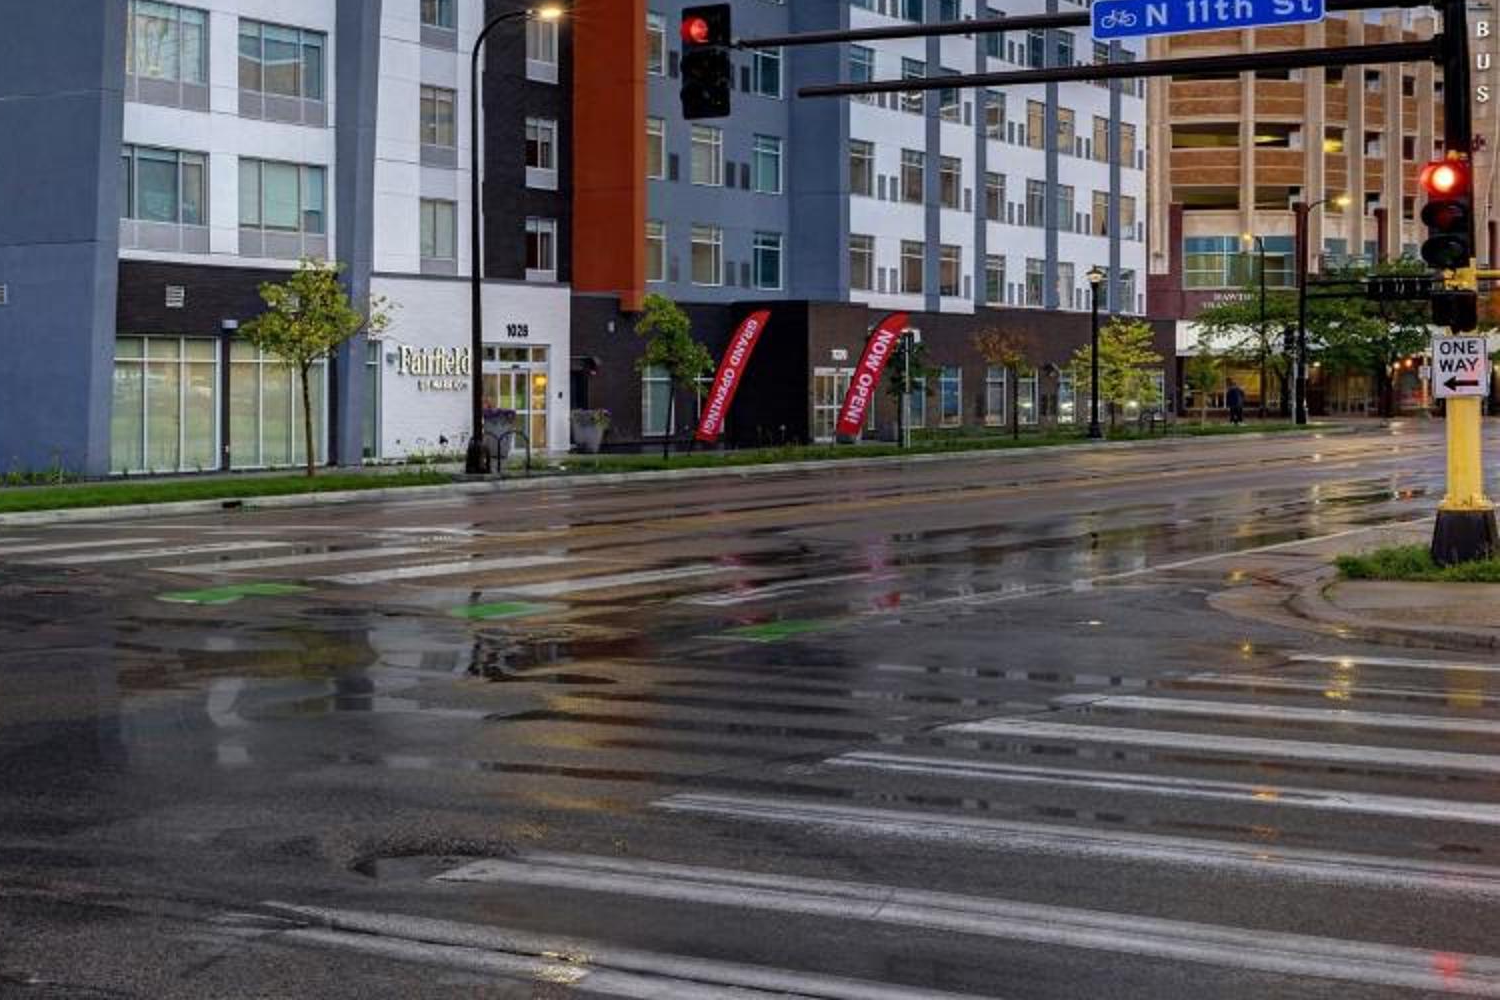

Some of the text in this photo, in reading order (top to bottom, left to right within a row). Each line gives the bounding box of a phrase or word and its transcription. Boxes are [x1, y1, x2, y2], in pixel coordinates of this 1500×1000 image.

[1145, 3, 1168, 27] N
[1476, 21, 1490, 103] BUS
[729, 319, 758, 367] GRAND
[865, 329, 895, 372] NOW
[1439, 341, 1477, 355] ONE
[397, 345, 471, 376] Fairfield
[1439, 359, 1479, 373] WAY
